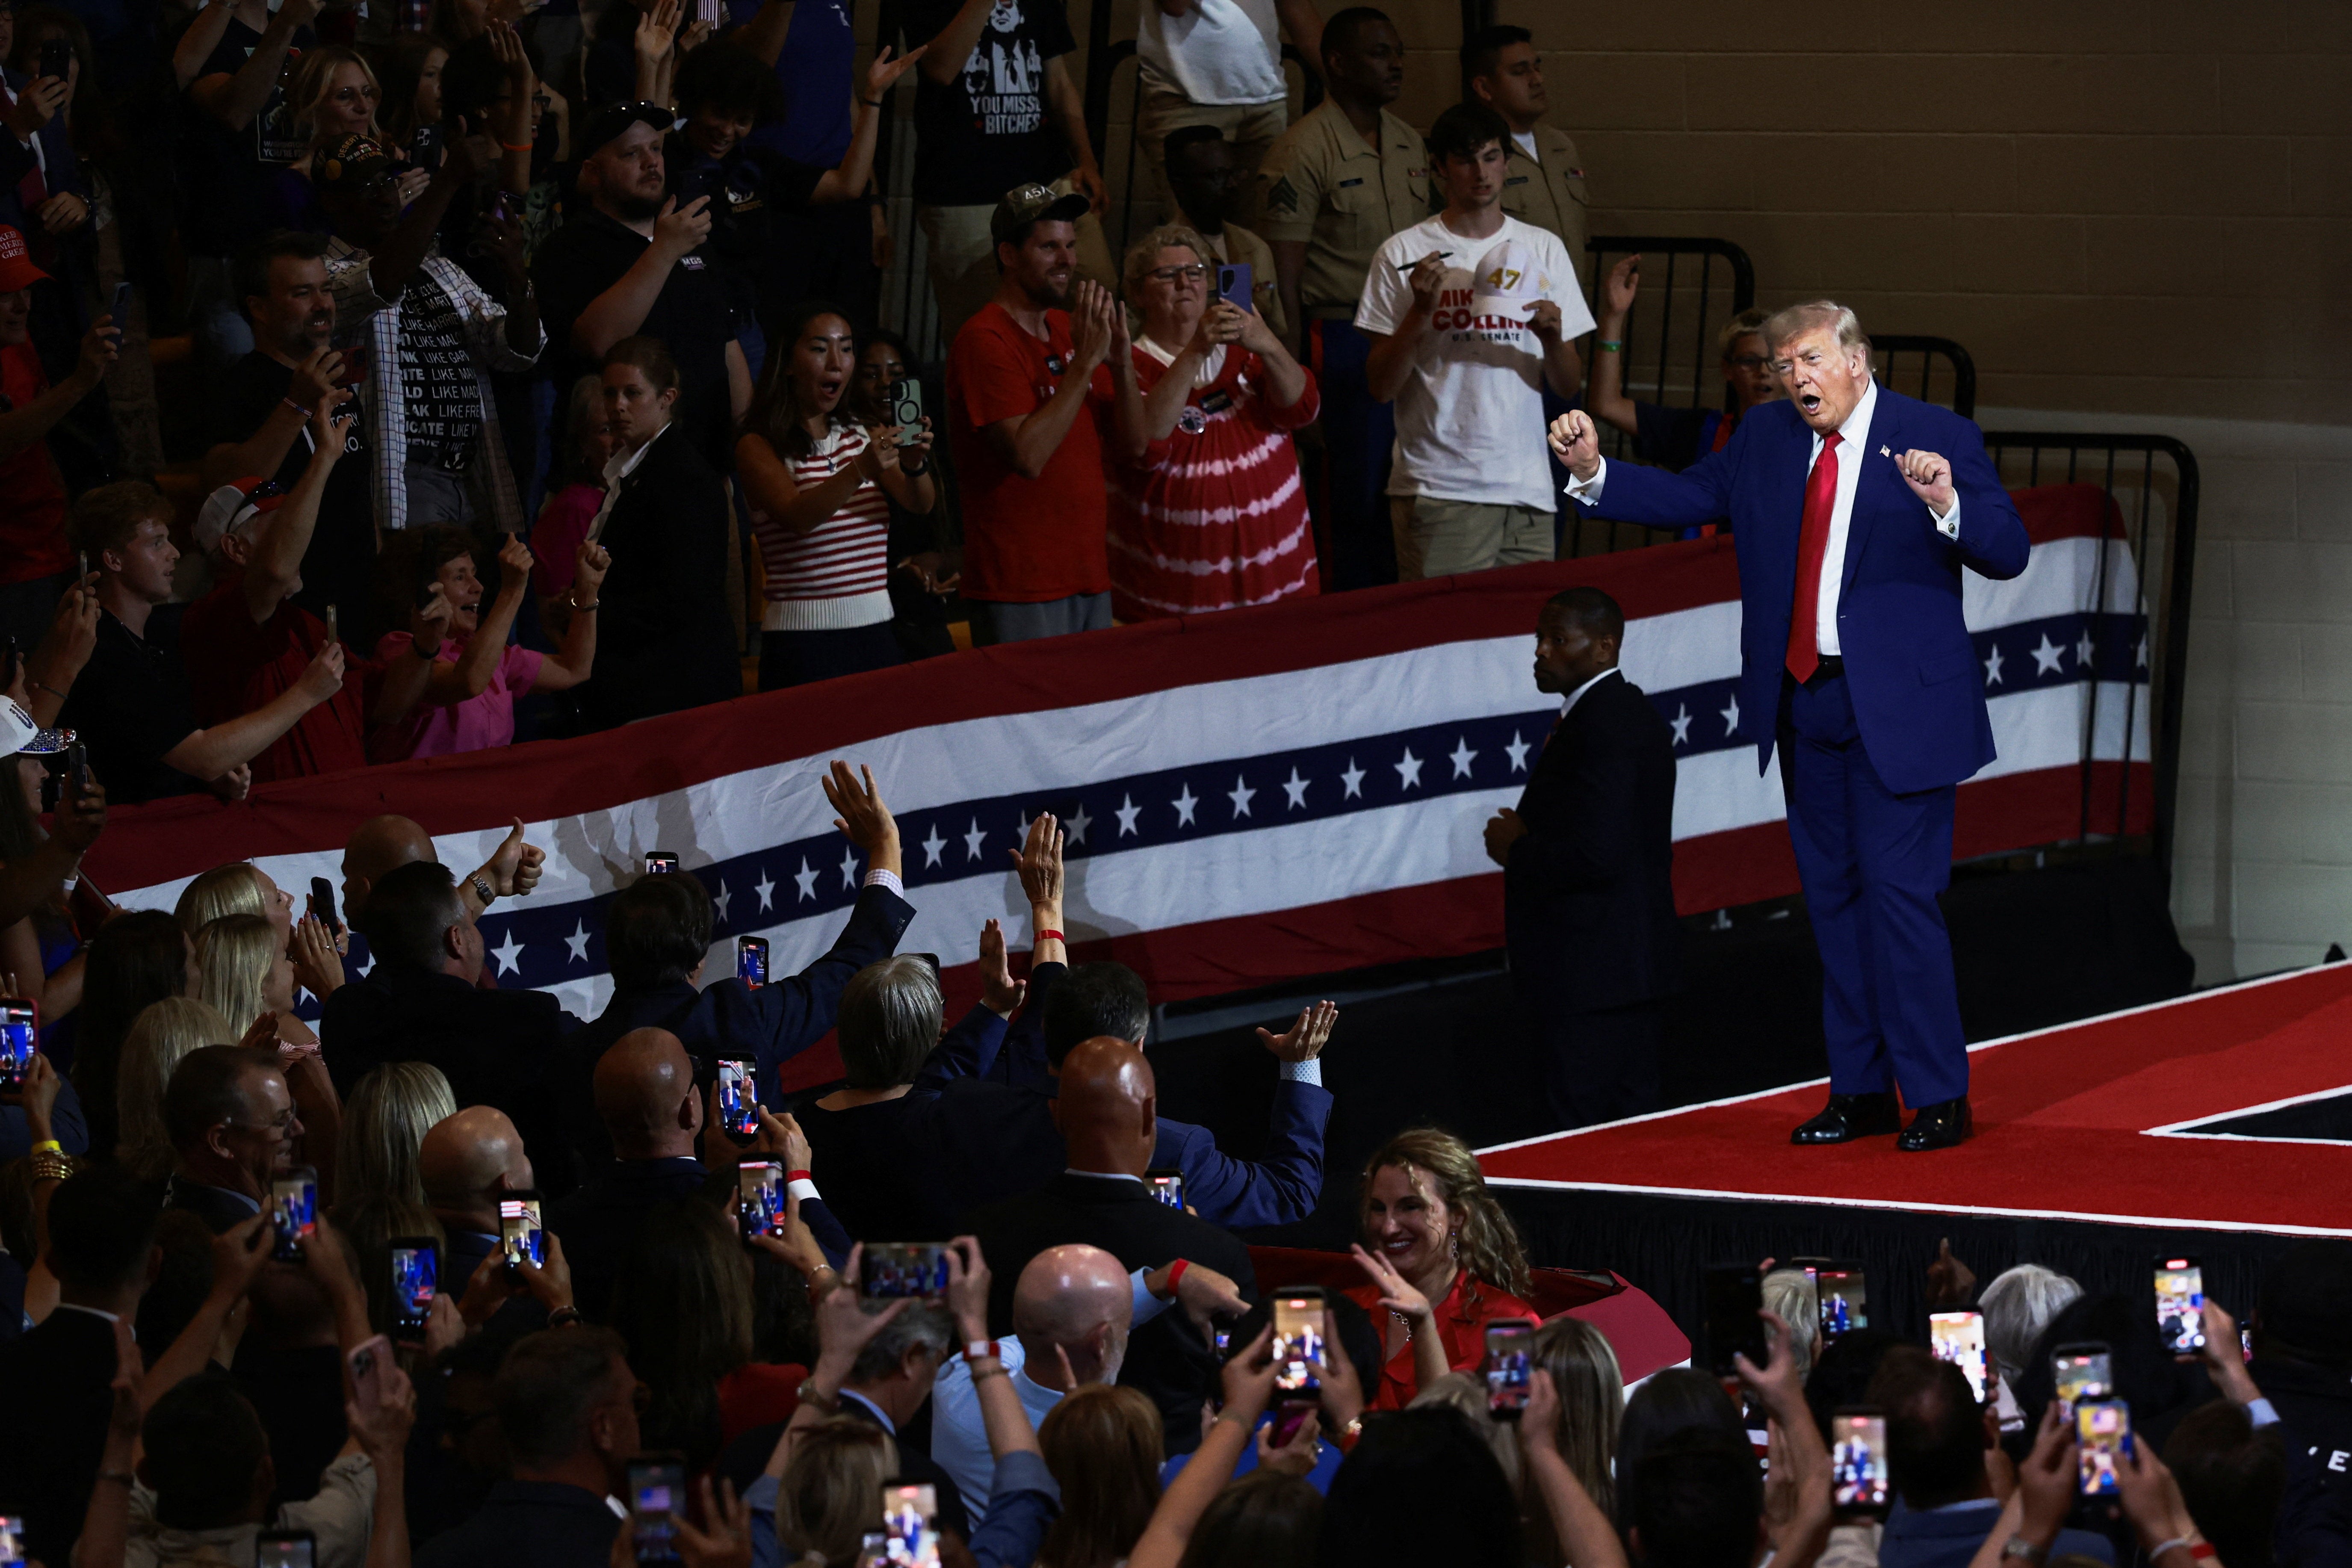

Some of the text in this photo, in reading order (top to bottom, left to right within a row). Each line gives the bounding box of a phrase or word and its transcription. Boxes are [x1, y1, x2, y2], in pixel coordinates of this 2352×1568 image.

[969, 95, 1001, 114] YOU
[984, 114, 1041, 135] BITCHES
[337, 134, 359, 158] DESERT
[1, 248, 25, 259] GREAT
[1488, 268, 1521, 290] 47
[425, 294, 451, 310] MART
[403, 318, 426, 331] LIKE
[1432, 308, 1533, 331] COLLIN
[413, 335, 438, 347] LIKE
[1480, 332, 1521, 342] SENATE
[400, 350, 419, 363] NK
[423, 351, 448, 364] LIKE
[431, 368, 458, 381] LIKE
[405, 385, 480, 399] LD LIKE MAD
[405, 404, 480, 418] EAK LIKE FRE
[405, 420, 445, 436] UCATE
[451, 423, 470, 437] LIKE
